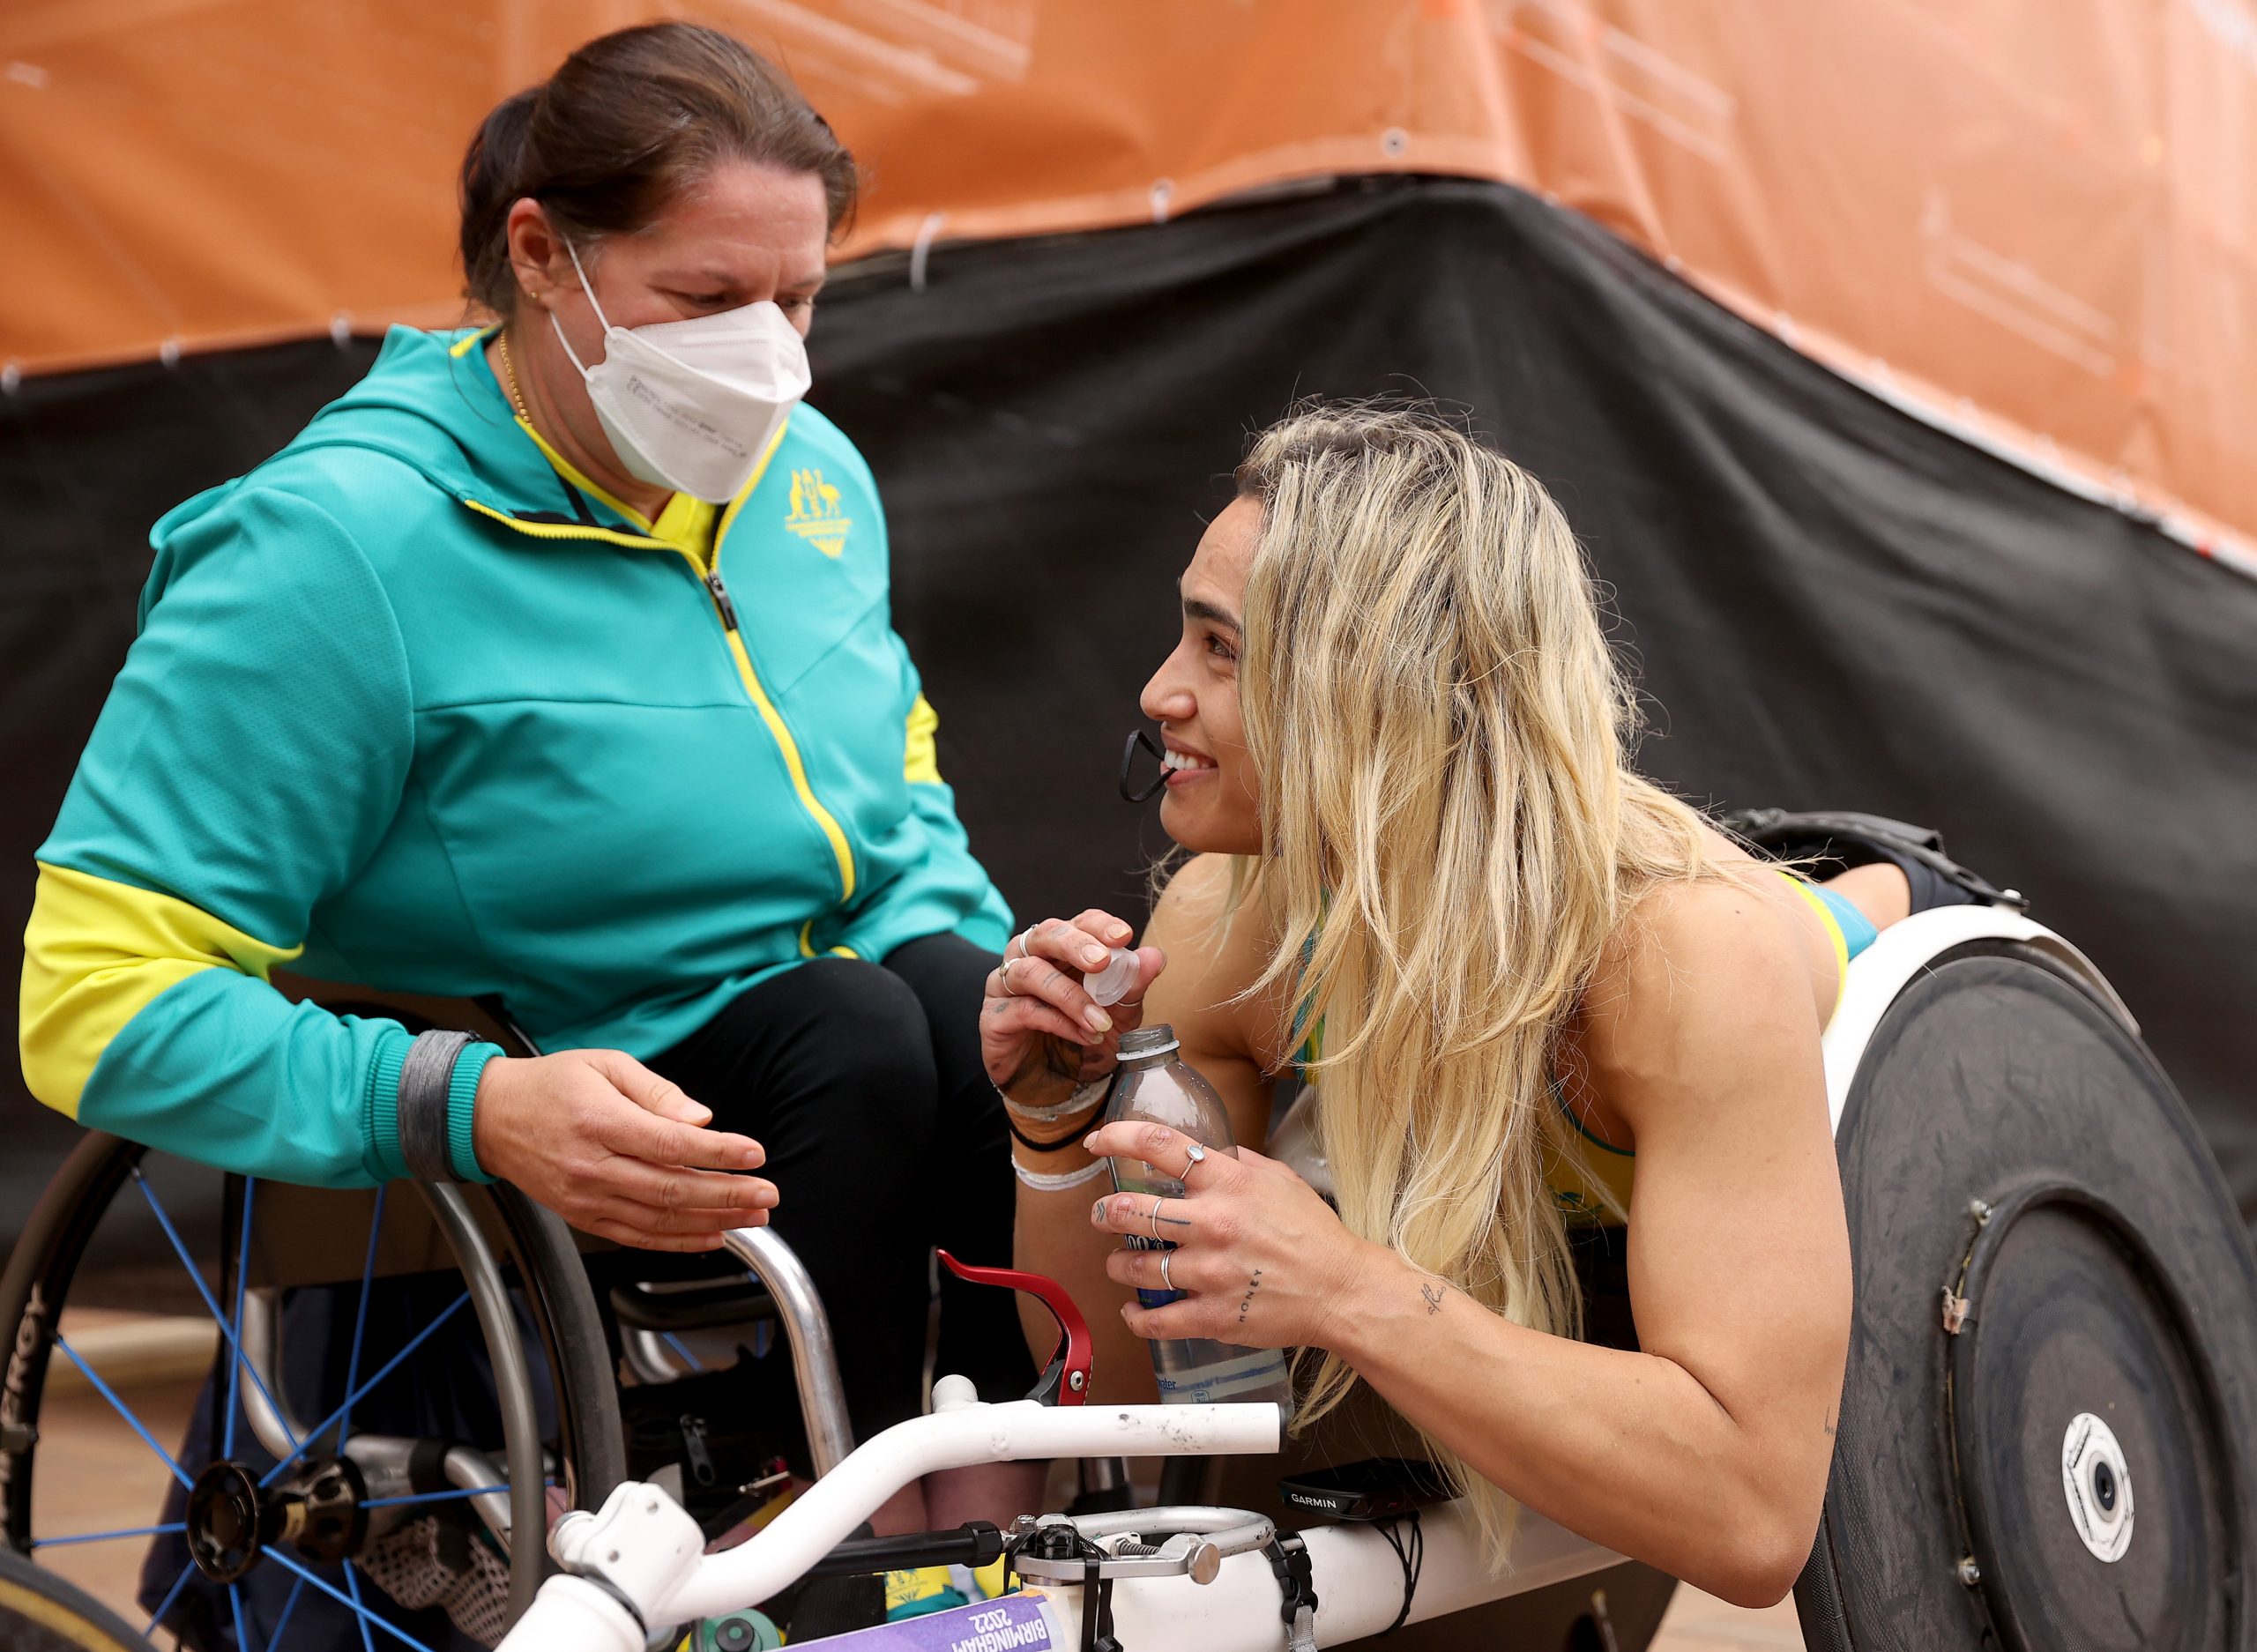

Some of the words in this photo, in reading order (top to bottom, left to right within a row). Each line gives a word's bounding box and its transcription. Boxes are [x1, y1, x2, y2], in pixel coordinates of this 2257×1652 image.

[1238, 1269, 1263, 1322] HONEY
[1291, 1493, 1337, 1509] GARMIN
[968, 1608, 1013, 1634] 2022
